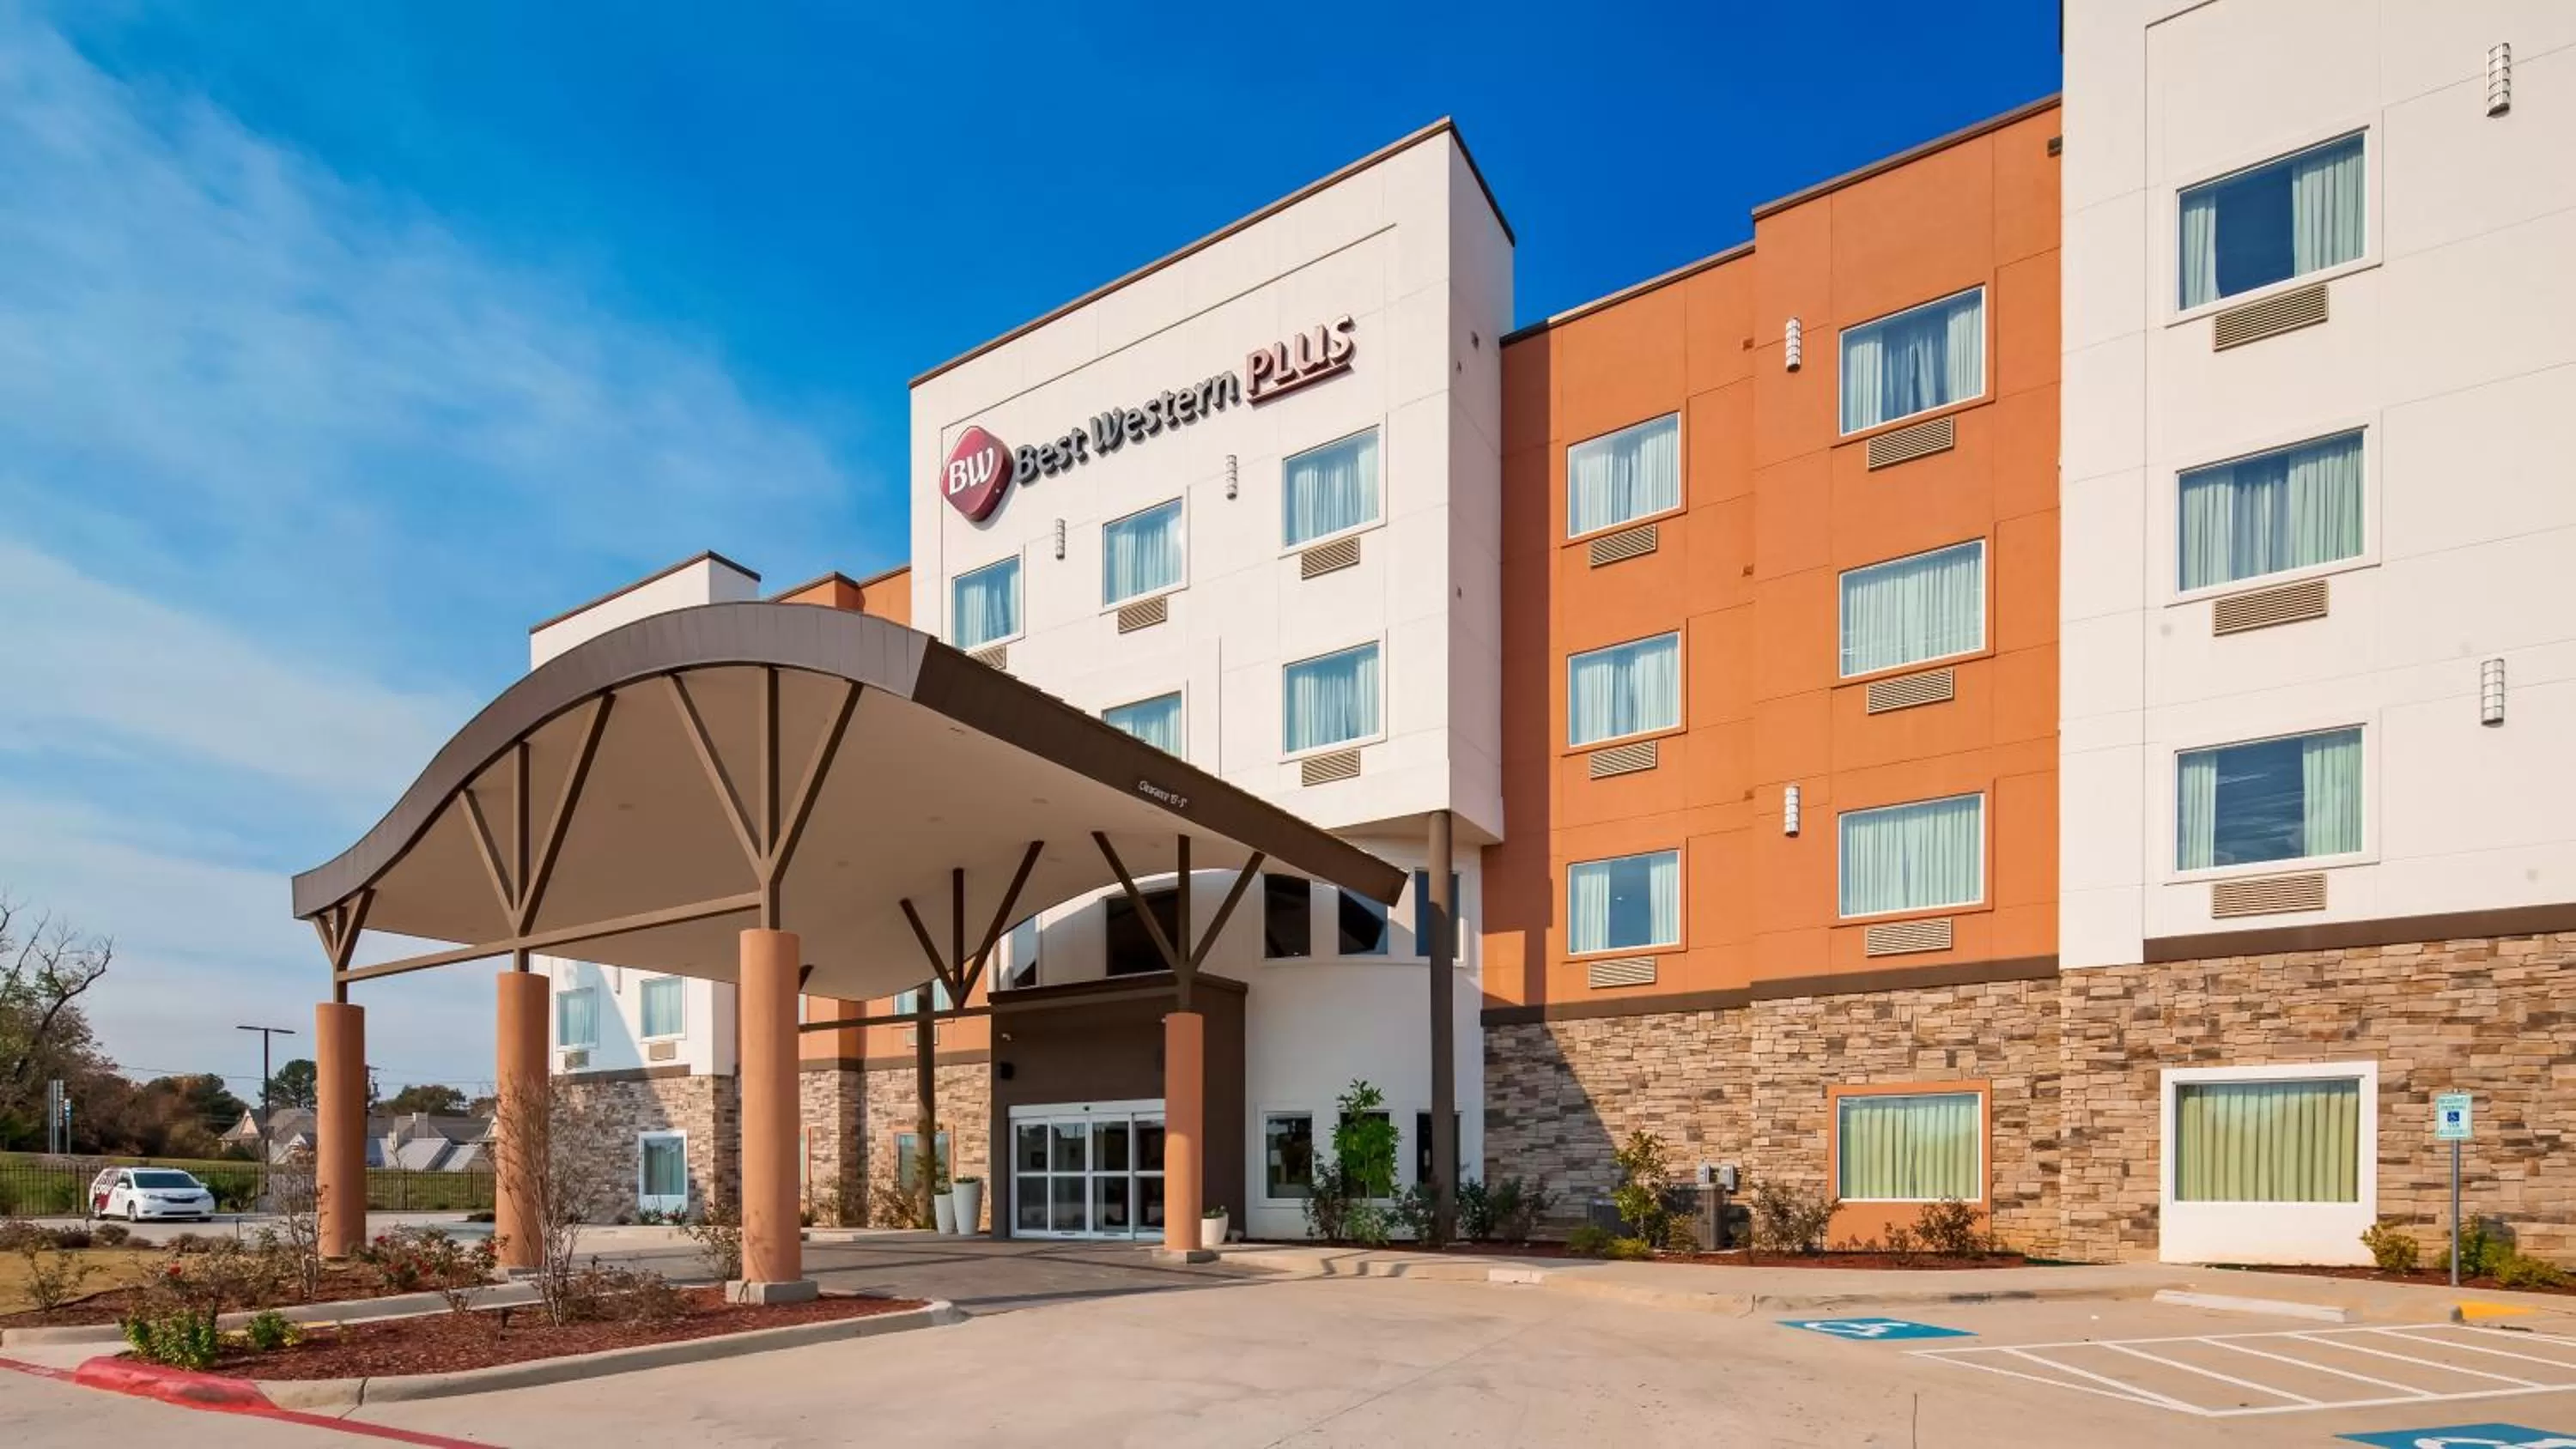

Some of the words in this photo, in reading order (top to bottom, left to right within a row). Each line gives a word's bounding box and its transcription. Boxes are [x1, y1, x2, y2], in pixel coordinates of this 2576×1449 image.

[1014, 427, 1087, 484] Best
[1089, 371, 1239, 454] Western
[1246, 314, 1354, 394] PLUS
[948, 446, 994, 495] BW
